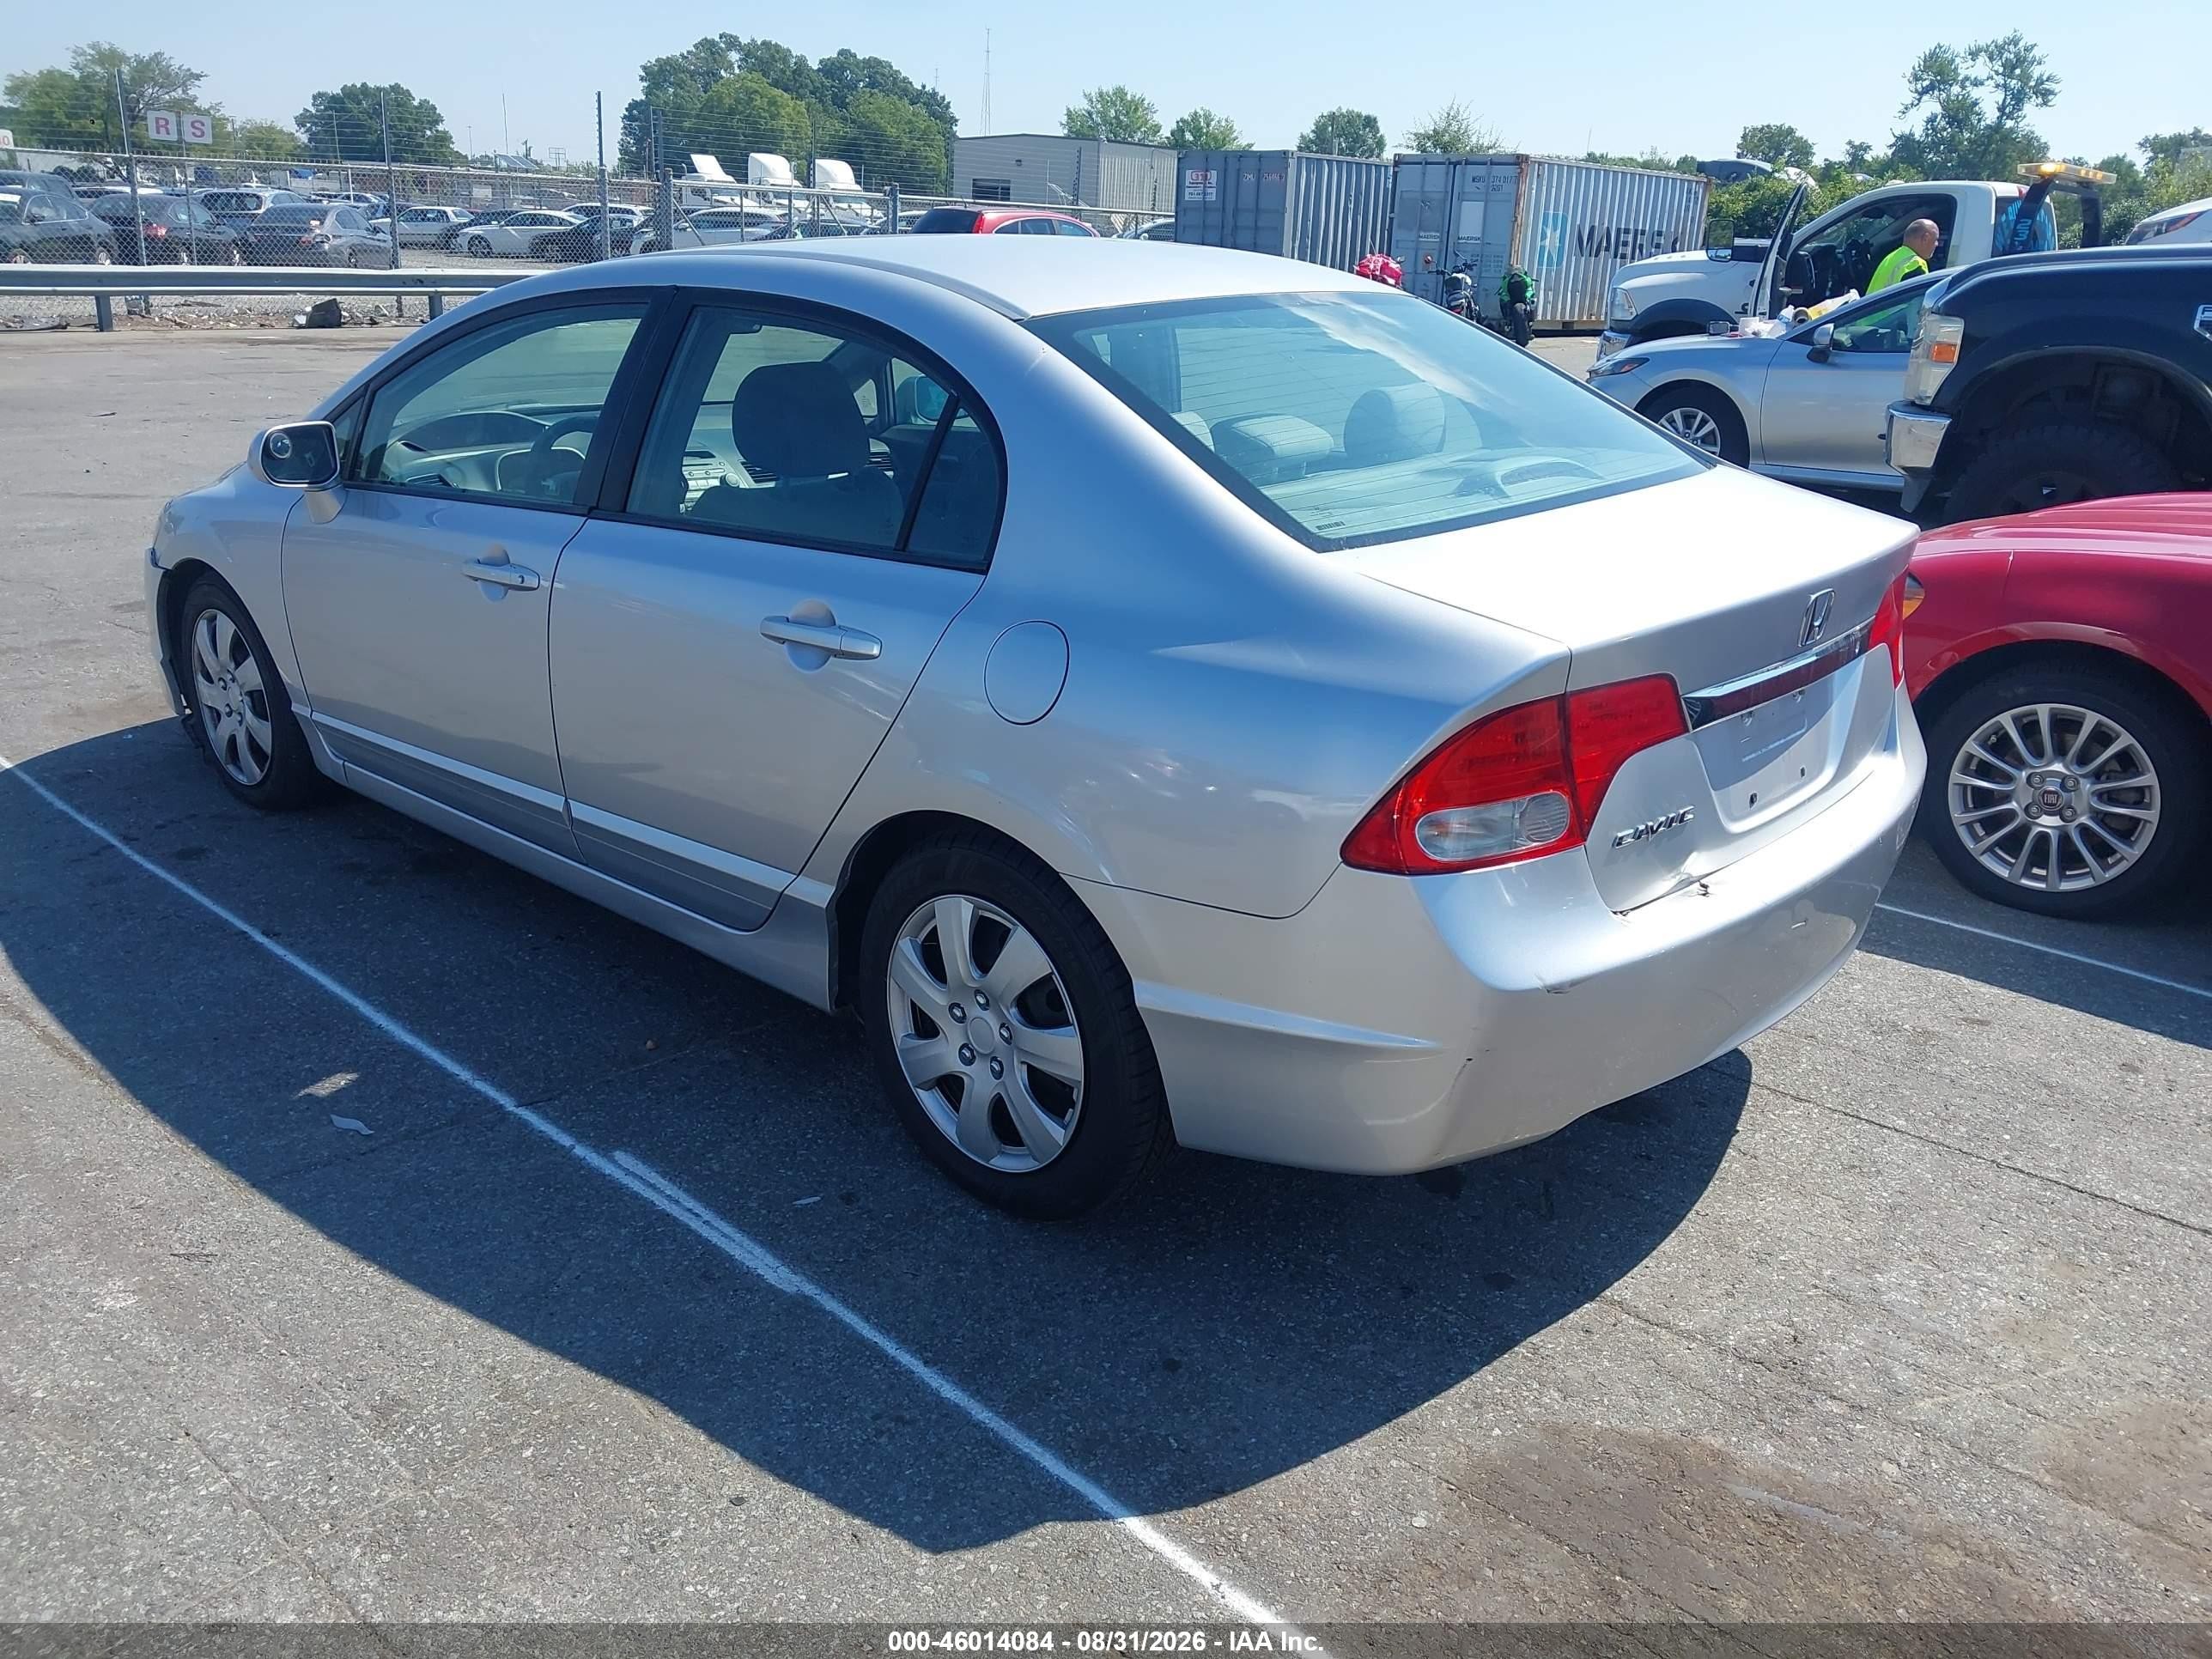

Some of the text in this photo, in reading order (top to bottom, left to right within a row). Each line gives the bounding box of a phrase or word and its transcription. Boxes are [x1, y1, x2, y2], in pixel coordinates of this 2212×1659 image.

[155, 116, 171, 136] R
[190, 118, 206, 138] S
[2044, 793, 2058, 805] FIAT
[1612, 805, 1695, 849] CIVIC
